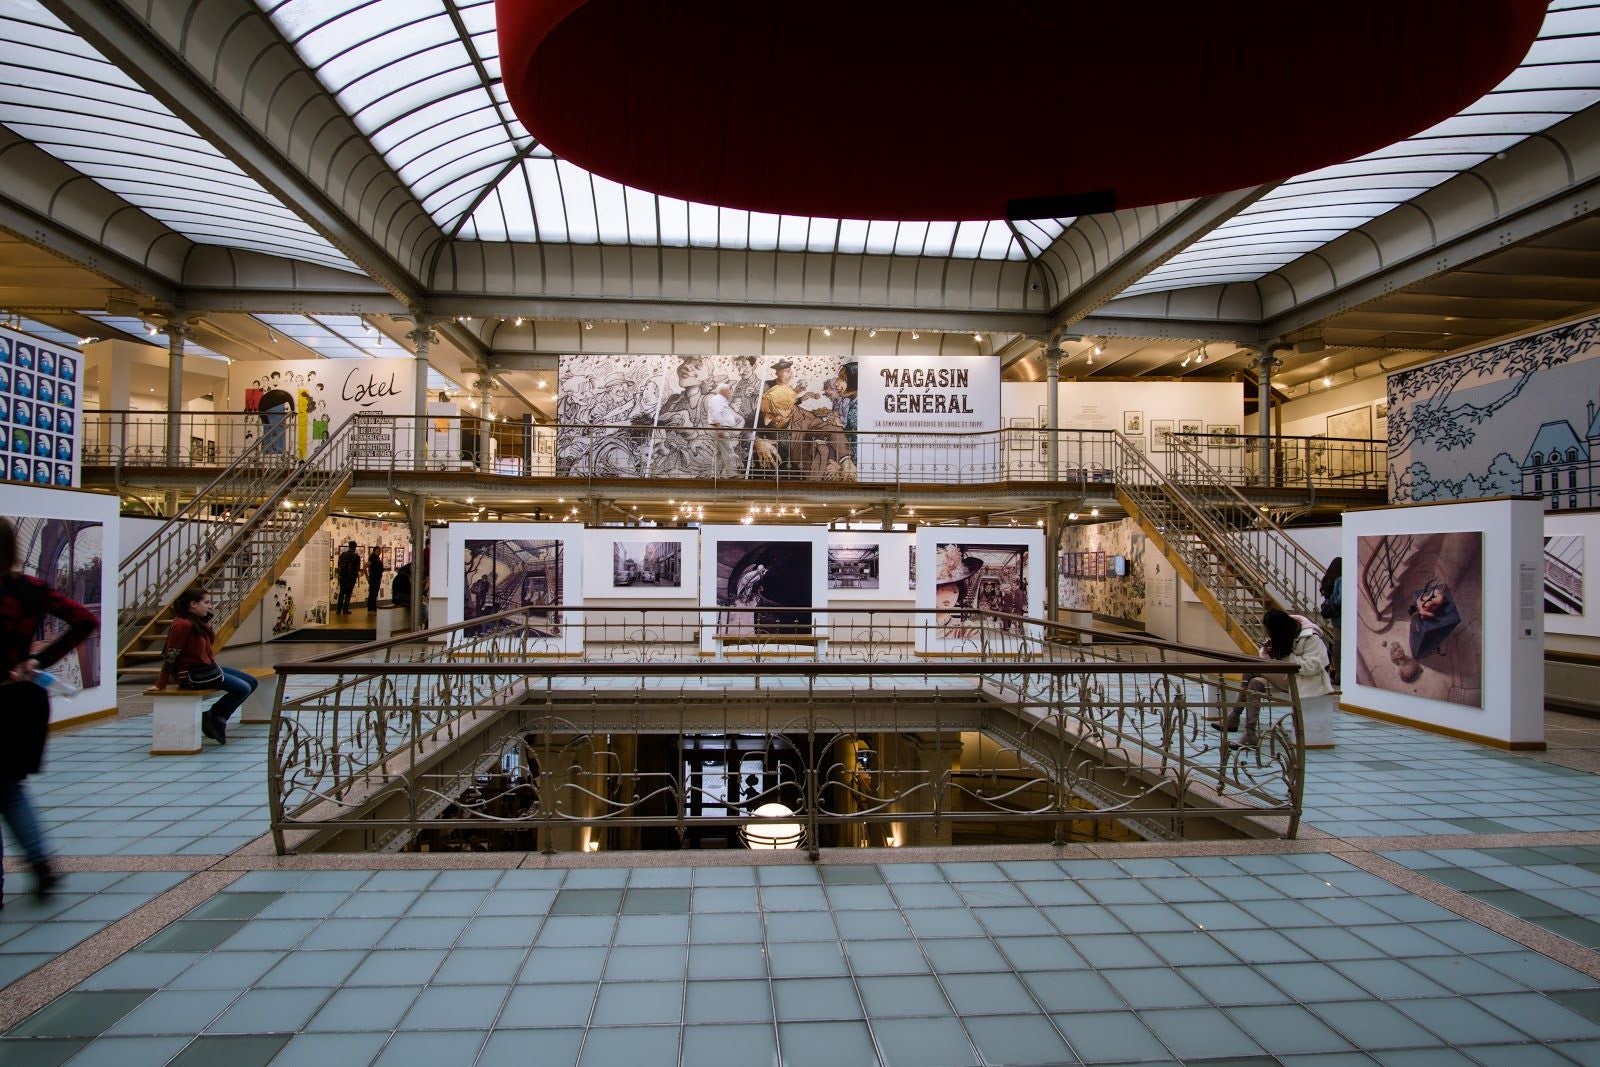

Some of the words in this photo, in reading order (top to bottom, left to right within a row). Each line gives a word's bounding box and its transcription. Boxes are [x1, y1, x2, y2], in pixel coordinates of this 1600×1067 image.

[342, 367, 402, 404] Catel
[880, 368, 969, 388] MAGASIN
[884, 388, 974, 413] GÉNÉRAL
